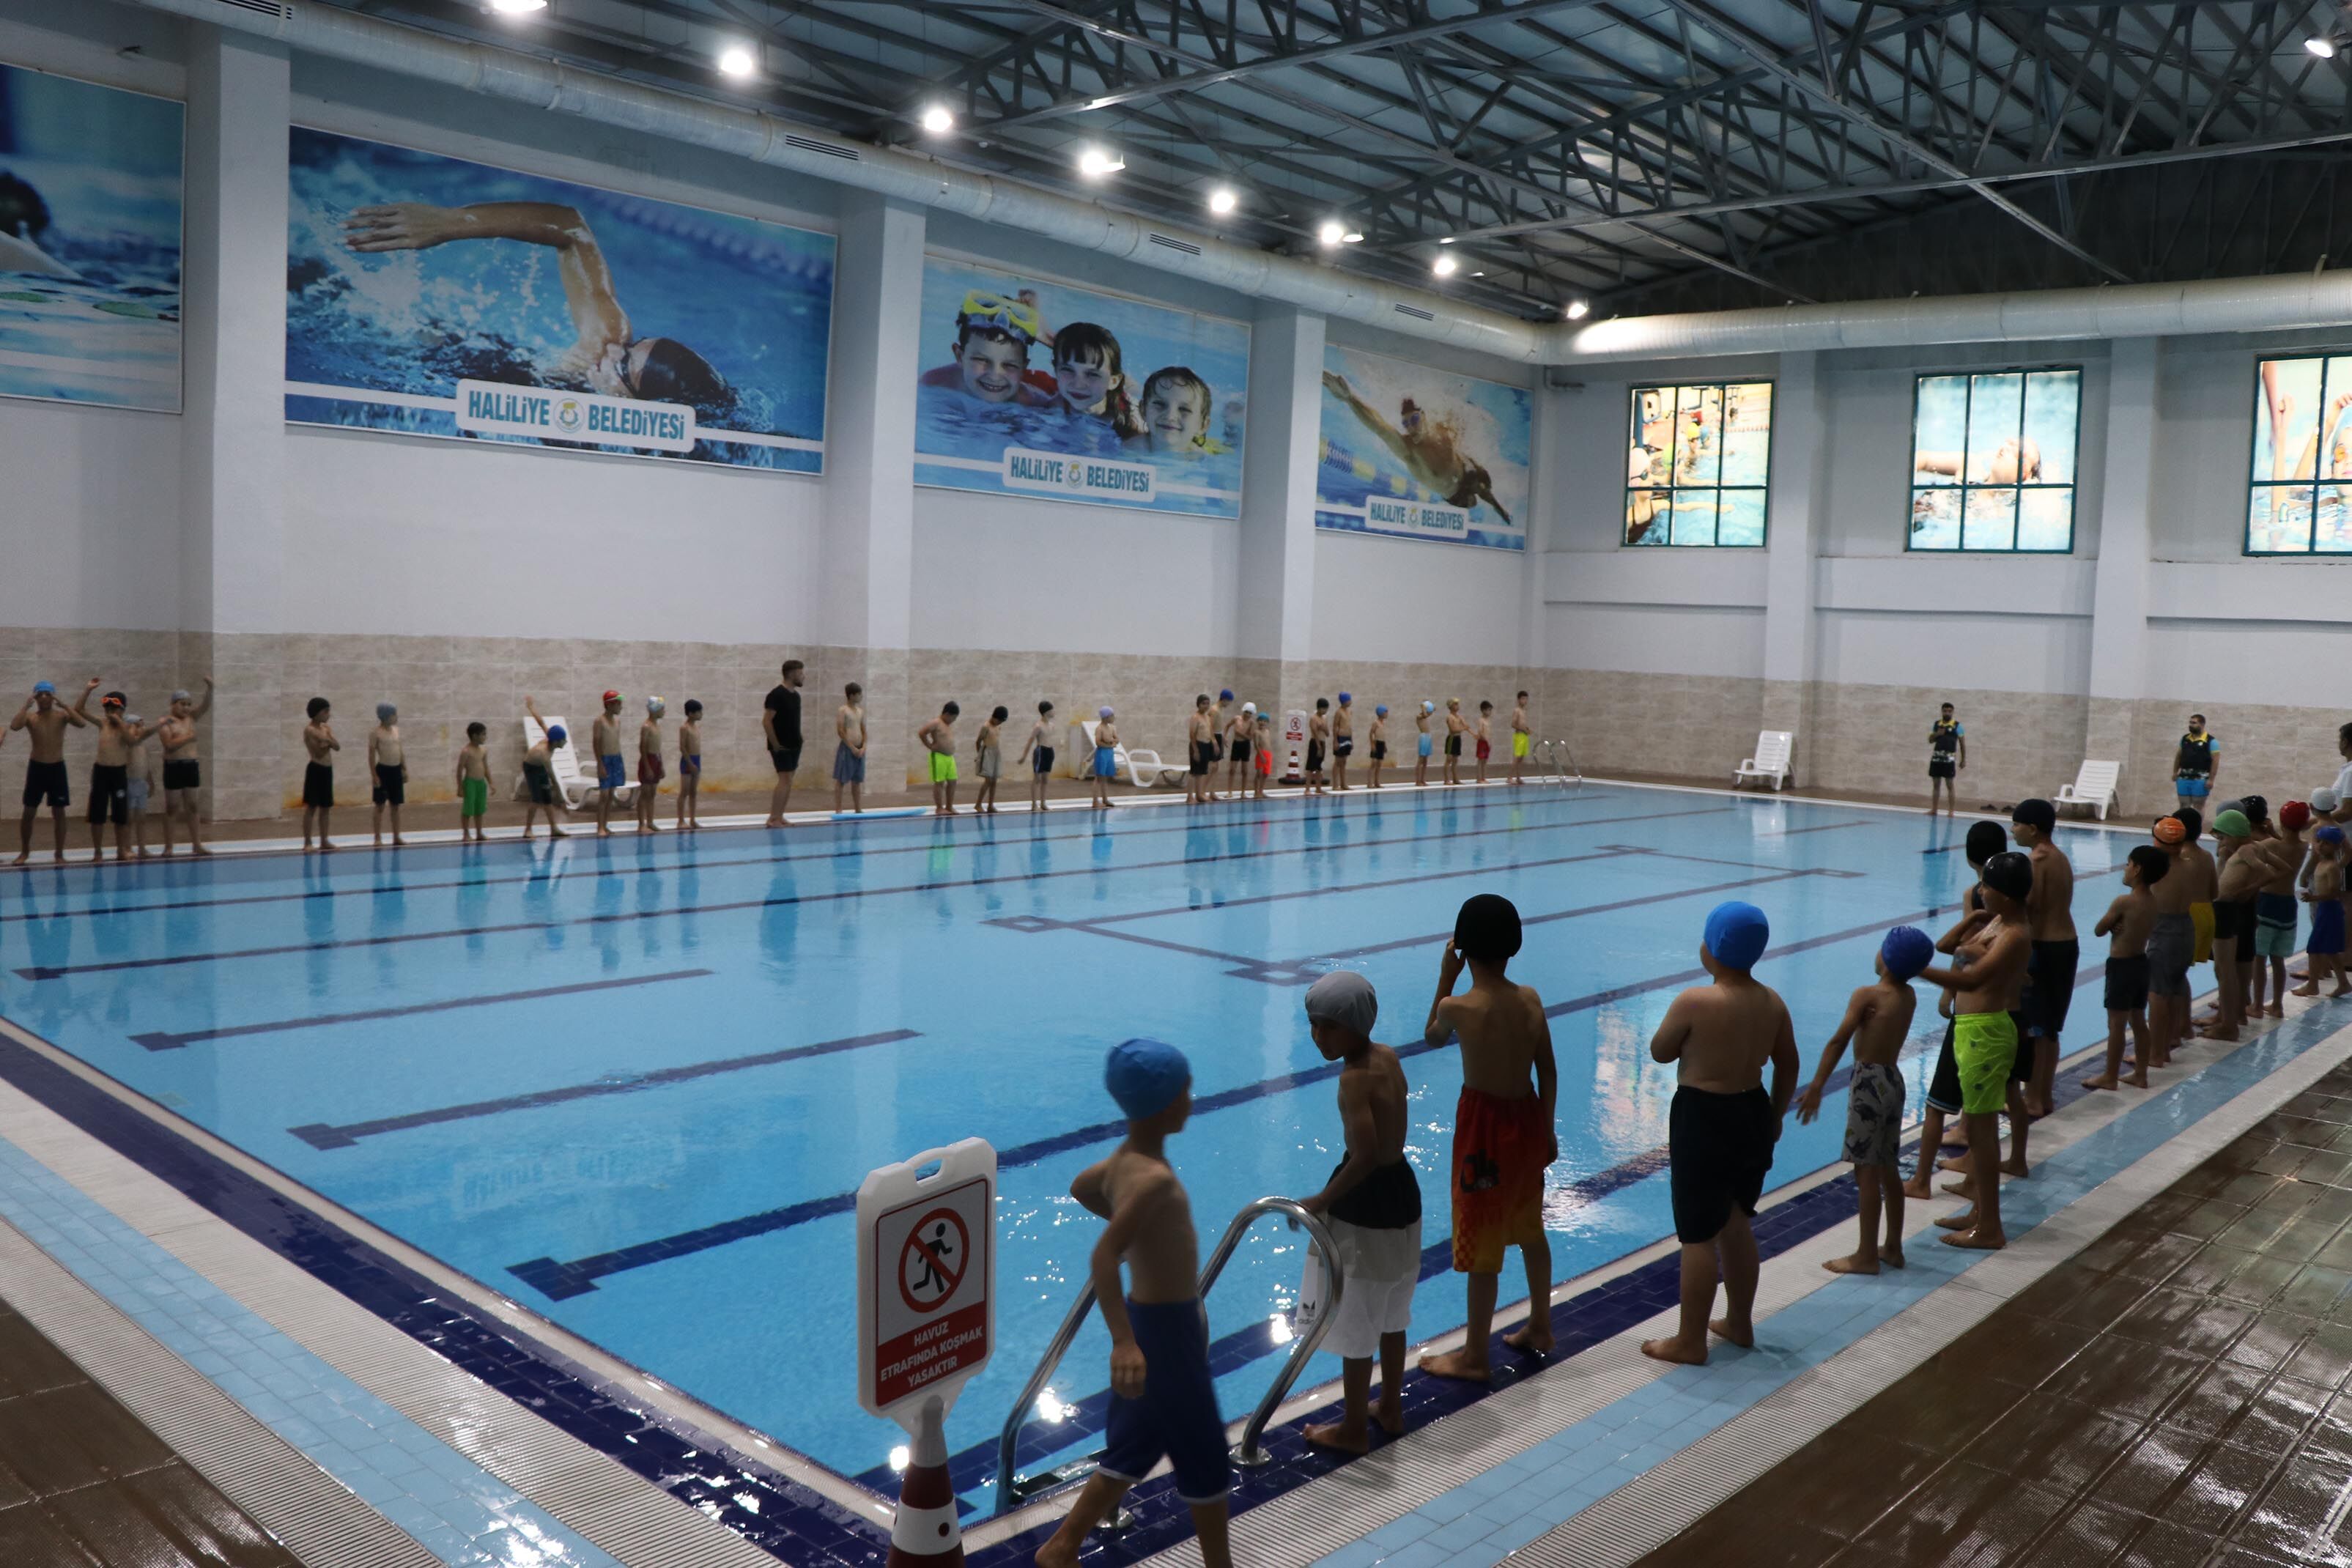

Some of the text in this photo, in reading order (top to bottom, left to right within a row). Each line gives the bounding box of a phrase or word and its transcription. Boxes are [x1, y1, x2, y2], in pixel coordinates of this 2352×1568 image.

[469, 390, 685, 440] HALİLİYE BELEDİYESİ
[1010, 455, 1150, 492] HALİLİYE BELEDİYESİ
[914, 1320, 950, 1347] HAVUZ
[880, 1325, 983, 1382] ETRAFINDA KOŞMAK
[908, 1356, 958, 1387] YASAKTIR
